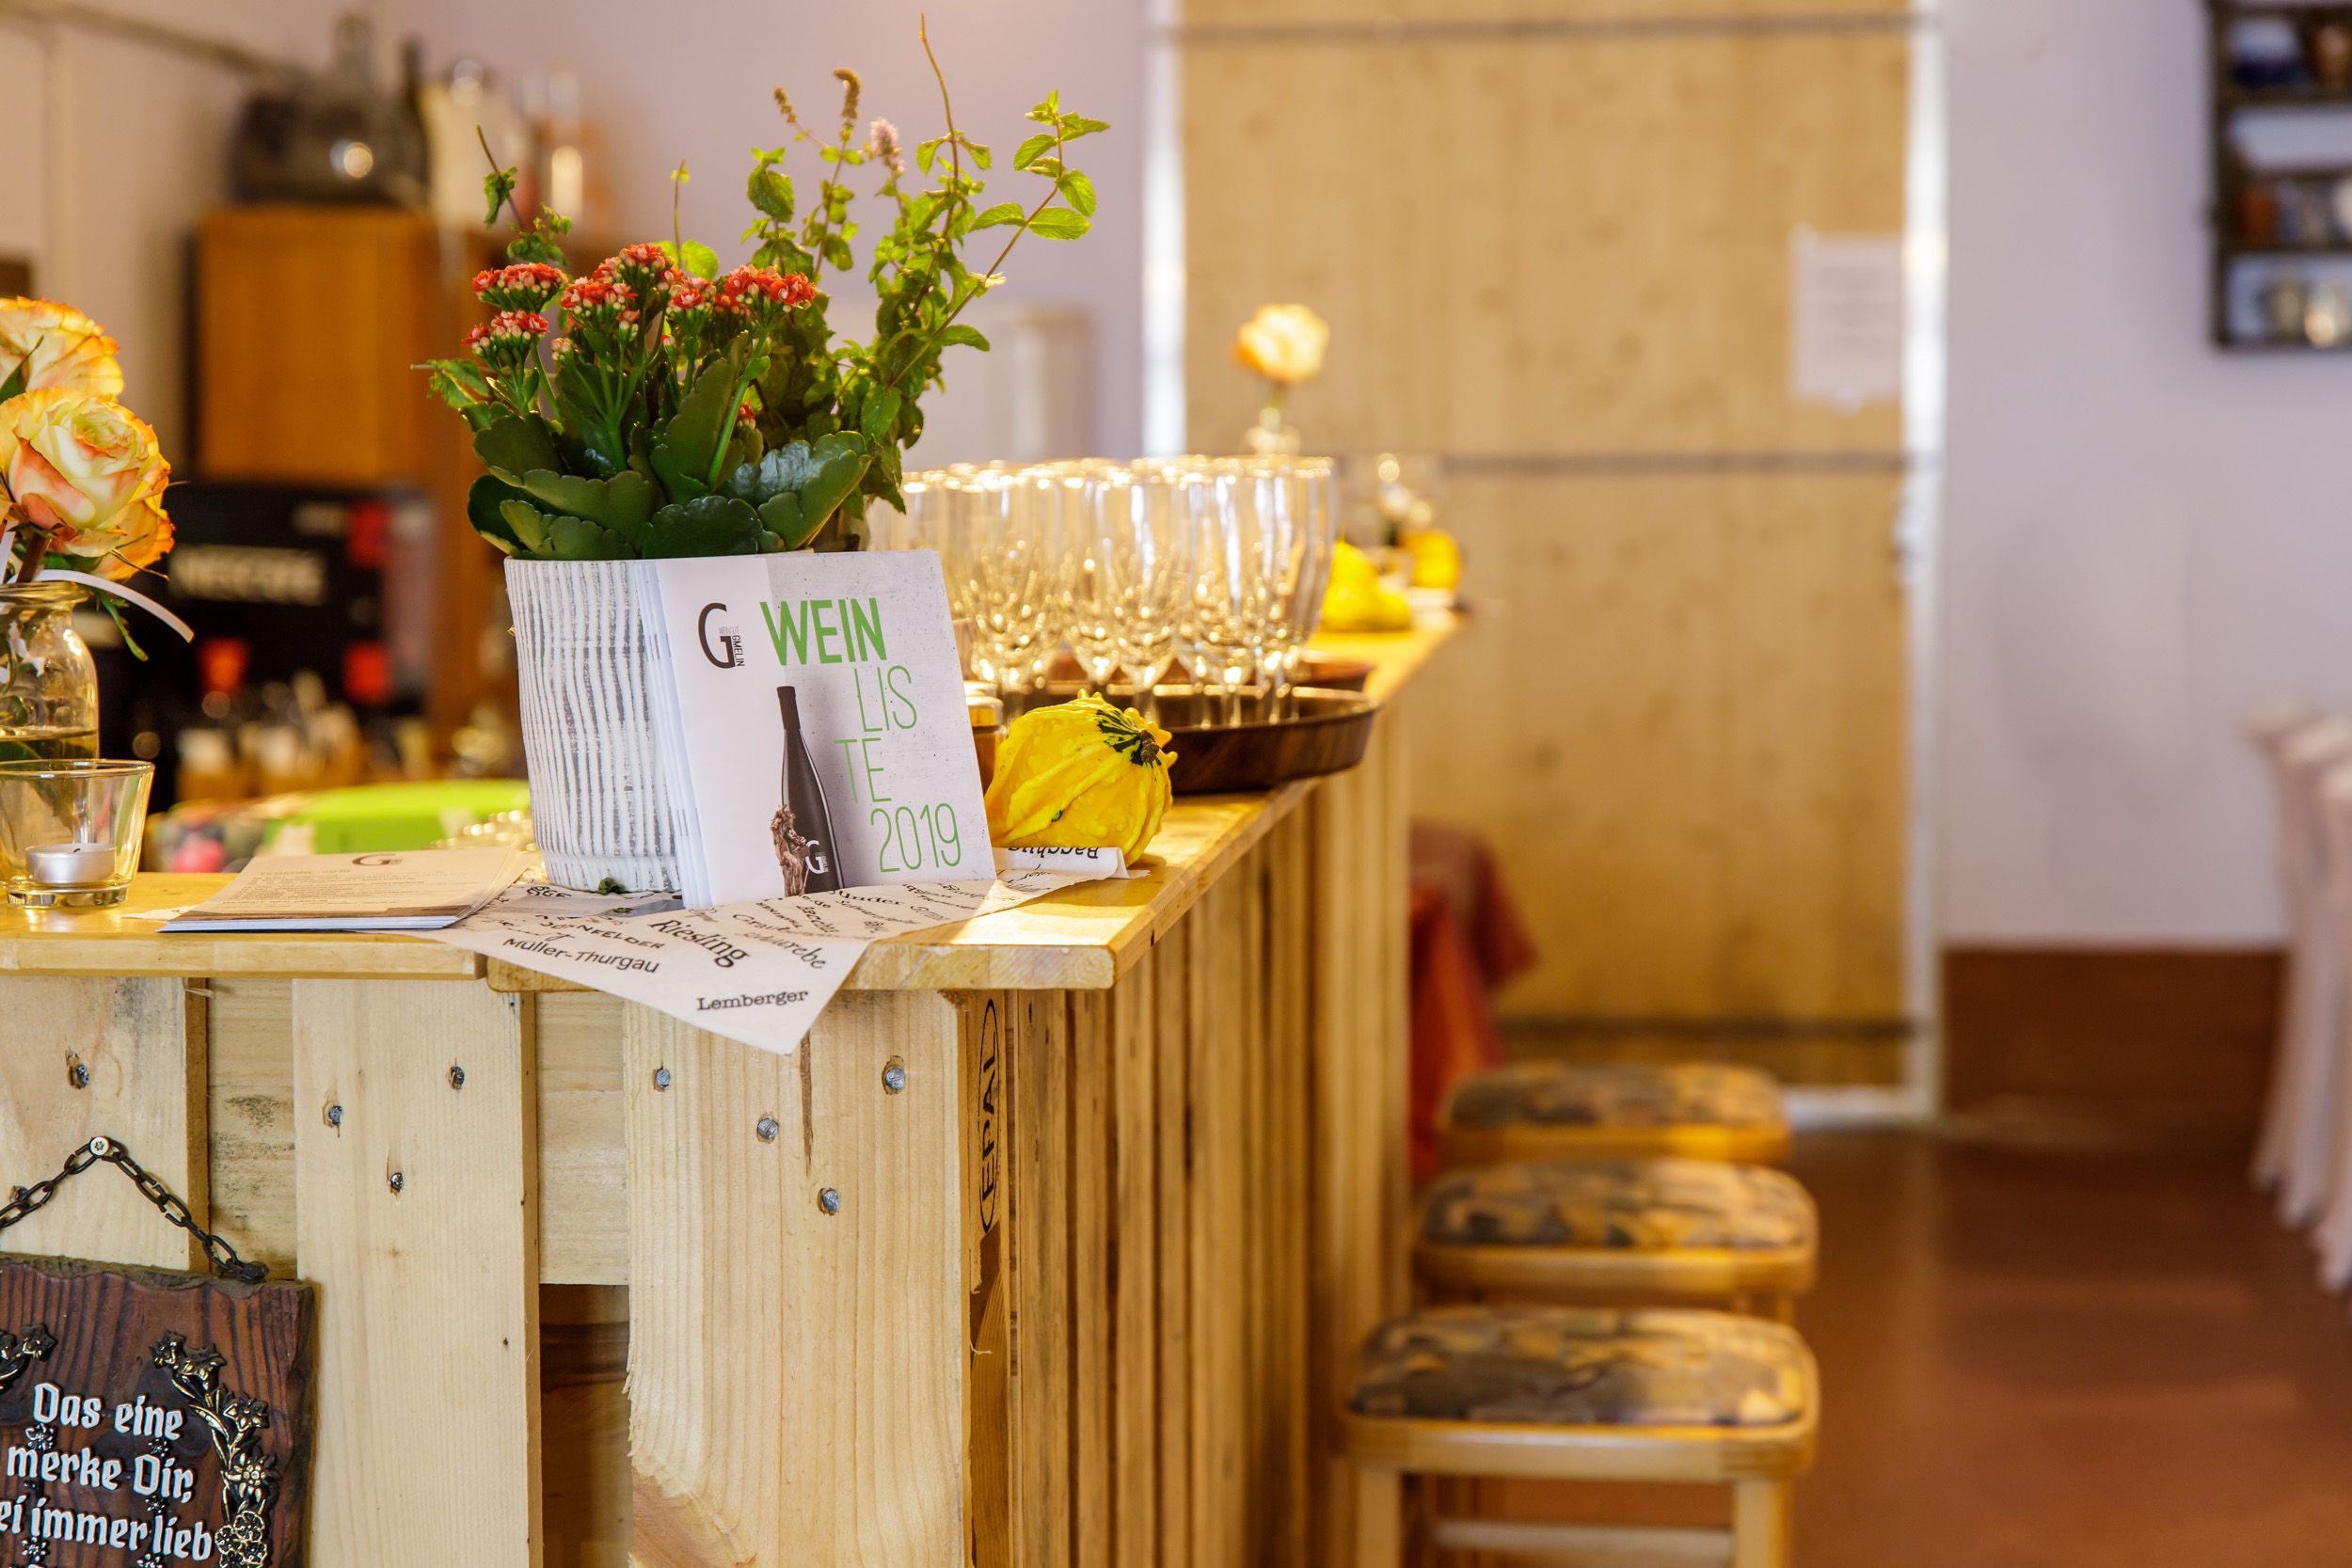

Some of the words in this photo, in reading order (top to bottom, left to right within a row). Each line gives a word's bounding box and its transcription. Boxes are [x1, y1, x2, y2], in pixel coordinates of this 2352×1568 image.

[698, 602, 736, 669] G
[732, 634, 745, 667] GMELIN
[759, 597, 887, 666] WEIN
[853, 665, 917, 733] LIS
[834, 736, 892, 803] TE
[870, 802, 961, 873] 2019
[502, 937, 660, 974] Müller-Thurgau
[647, 919, 750, 969] Riesling
[697, 990, 809, 1011] Lemberger
[982, 1030, 996, 1201] EPAL
[33, 1382, 103, 1429] Das
[114, 1394, 183, 1441] eine
[7, 1446, 122, 1490] merke
[133, 1453, 195, 1504] Dir,
[30, 1497, 150, 1551] immer
[151, 1513, 215, 1561] lieb
